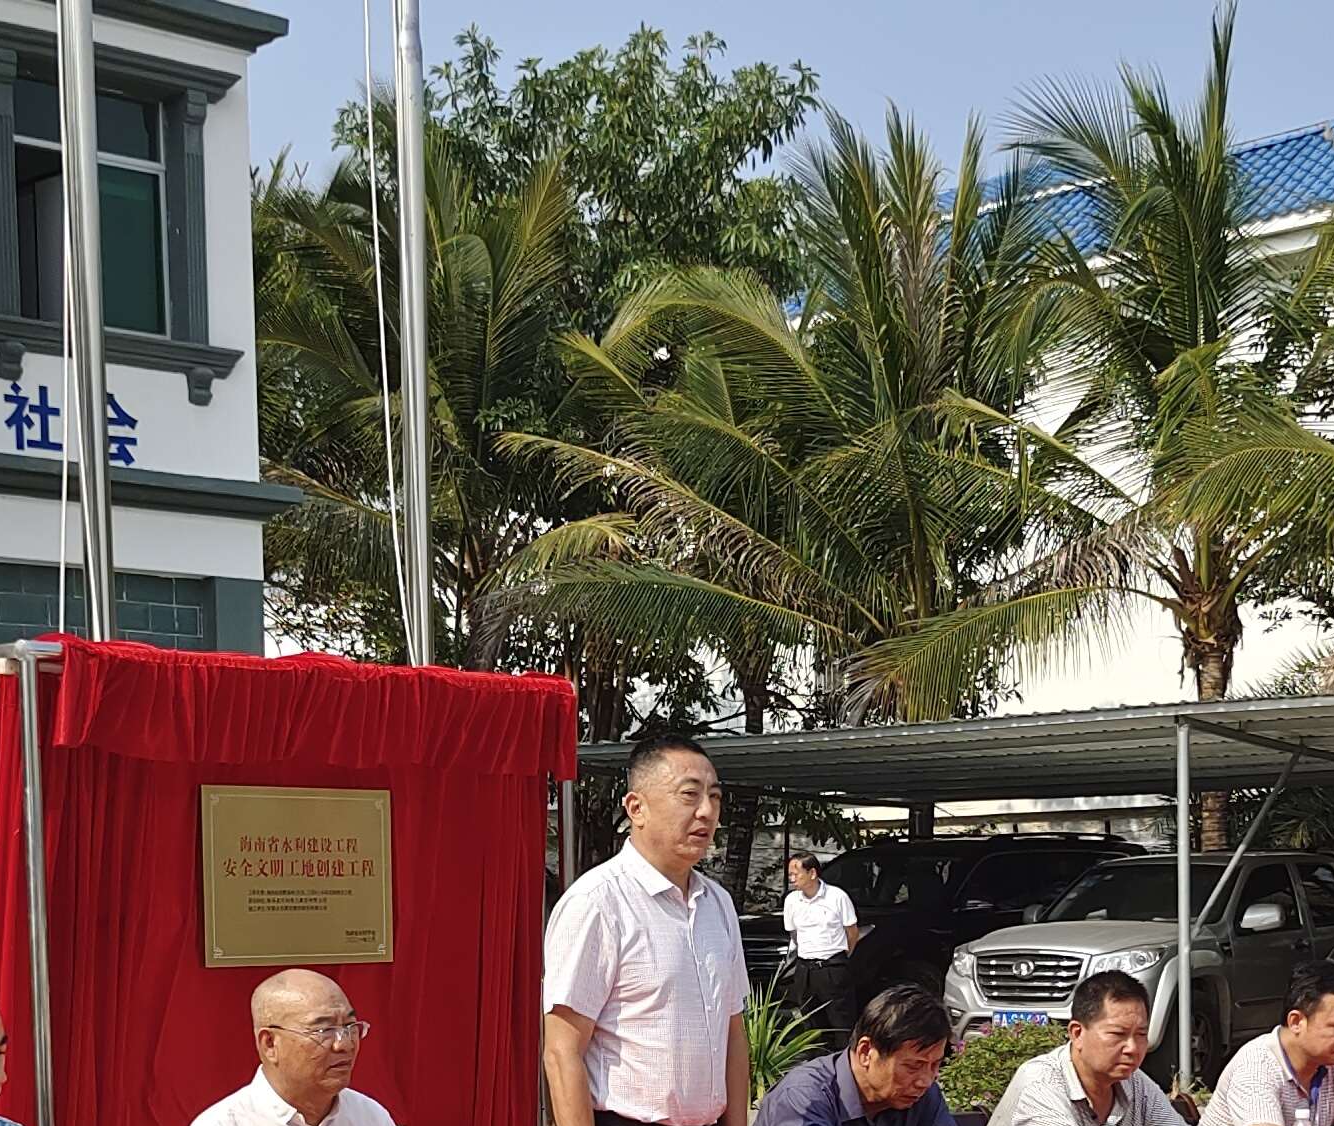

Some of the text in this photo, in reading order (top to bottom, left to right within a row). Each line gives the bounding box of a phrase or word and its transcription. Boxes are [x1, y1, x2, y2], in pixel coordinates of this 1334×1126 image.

[239, 835, 358, 853] 海南省水利建设工程
[223, 858, 376, 878] 安全文明工地创建工程
